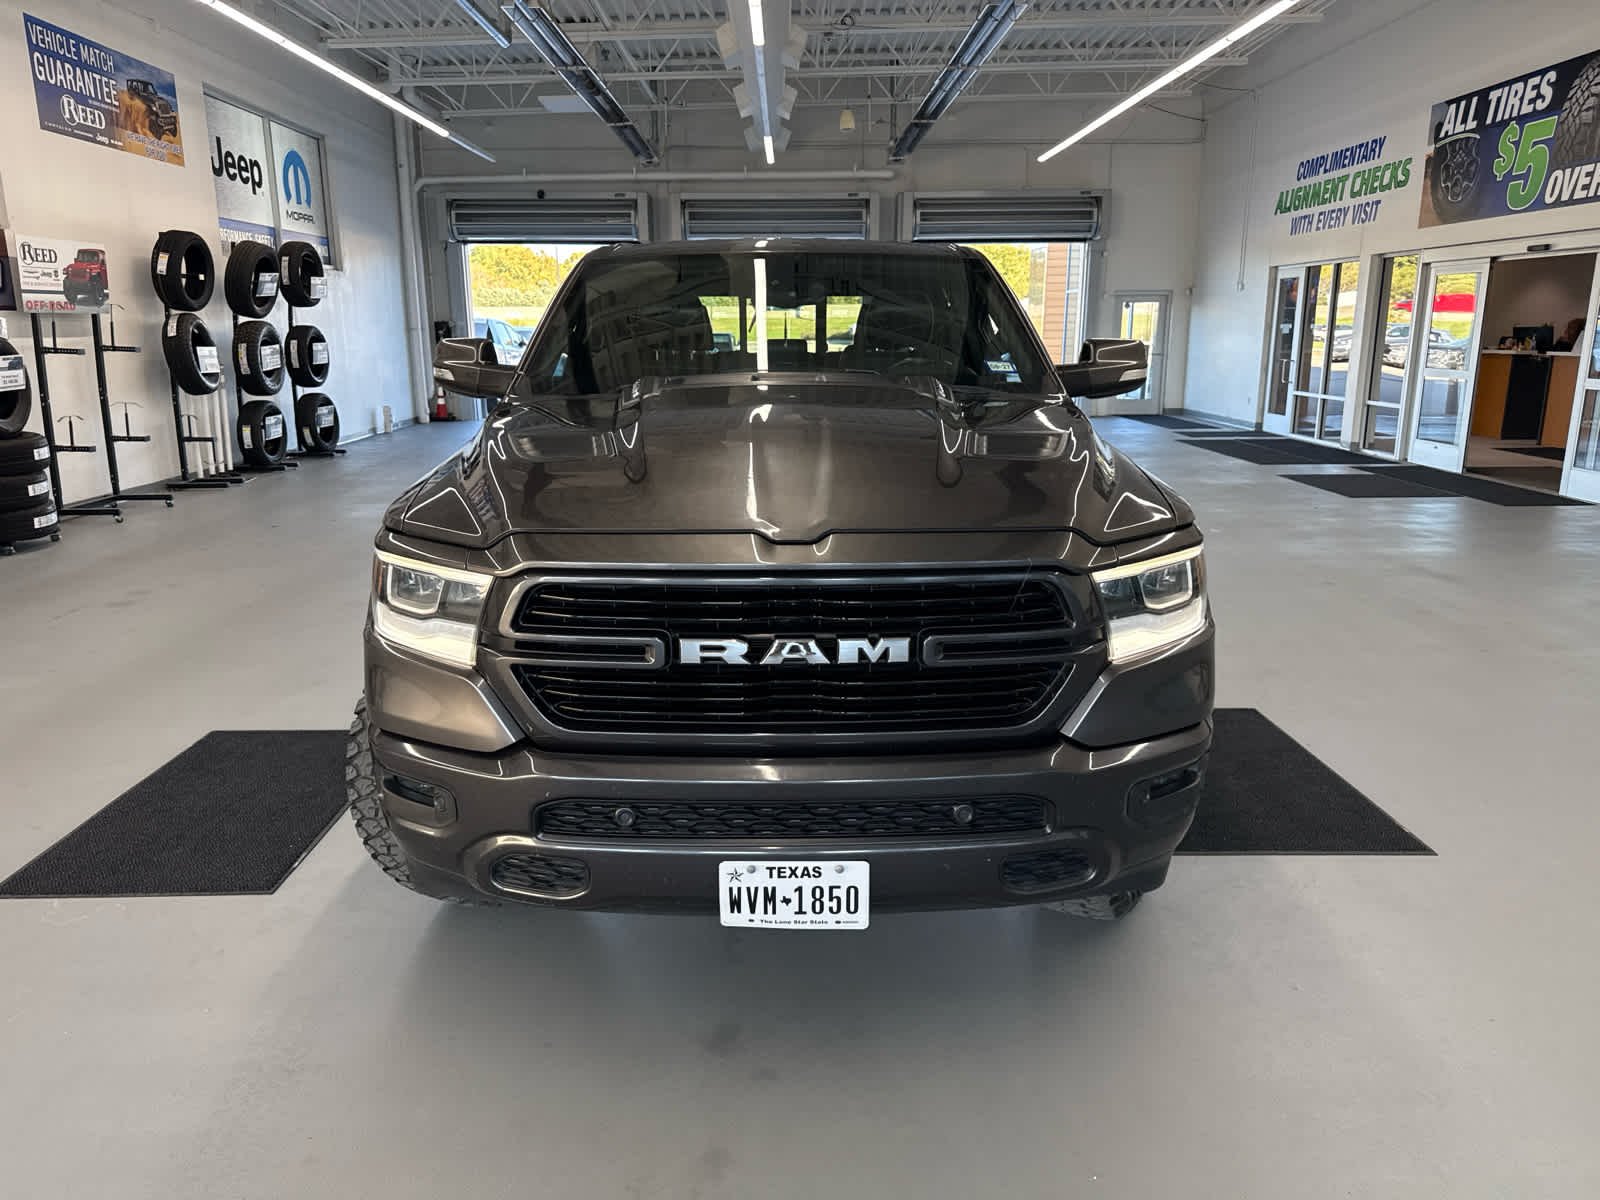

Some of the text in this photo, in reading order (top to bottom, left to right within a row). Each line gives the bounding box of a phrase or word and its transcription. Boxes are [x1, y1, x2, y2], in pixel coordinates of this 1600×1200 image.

[27, 21, 115, 74] VEHICLE MATCH
[33, 52, 120, 106] GUARANTEE
[1439, 70, 1557, 138] ALL TIRES
[60, 94, 106, 129] REED
[210, 136, 263, 195] Jeep
[1296, 135, 1387, 182] COMPLIMENTARY
[1493, 115, 1558, 210] $5
[1274, 157, 1413, 215] ALIGNMENT CHECKS
[1290, 200, 1381, 236] WITH EVERY VISIT
[20, 242, 57, 265] REED
[679, 637, 911, 664] RAM
[766, 866, 823, 879] TEXAS
